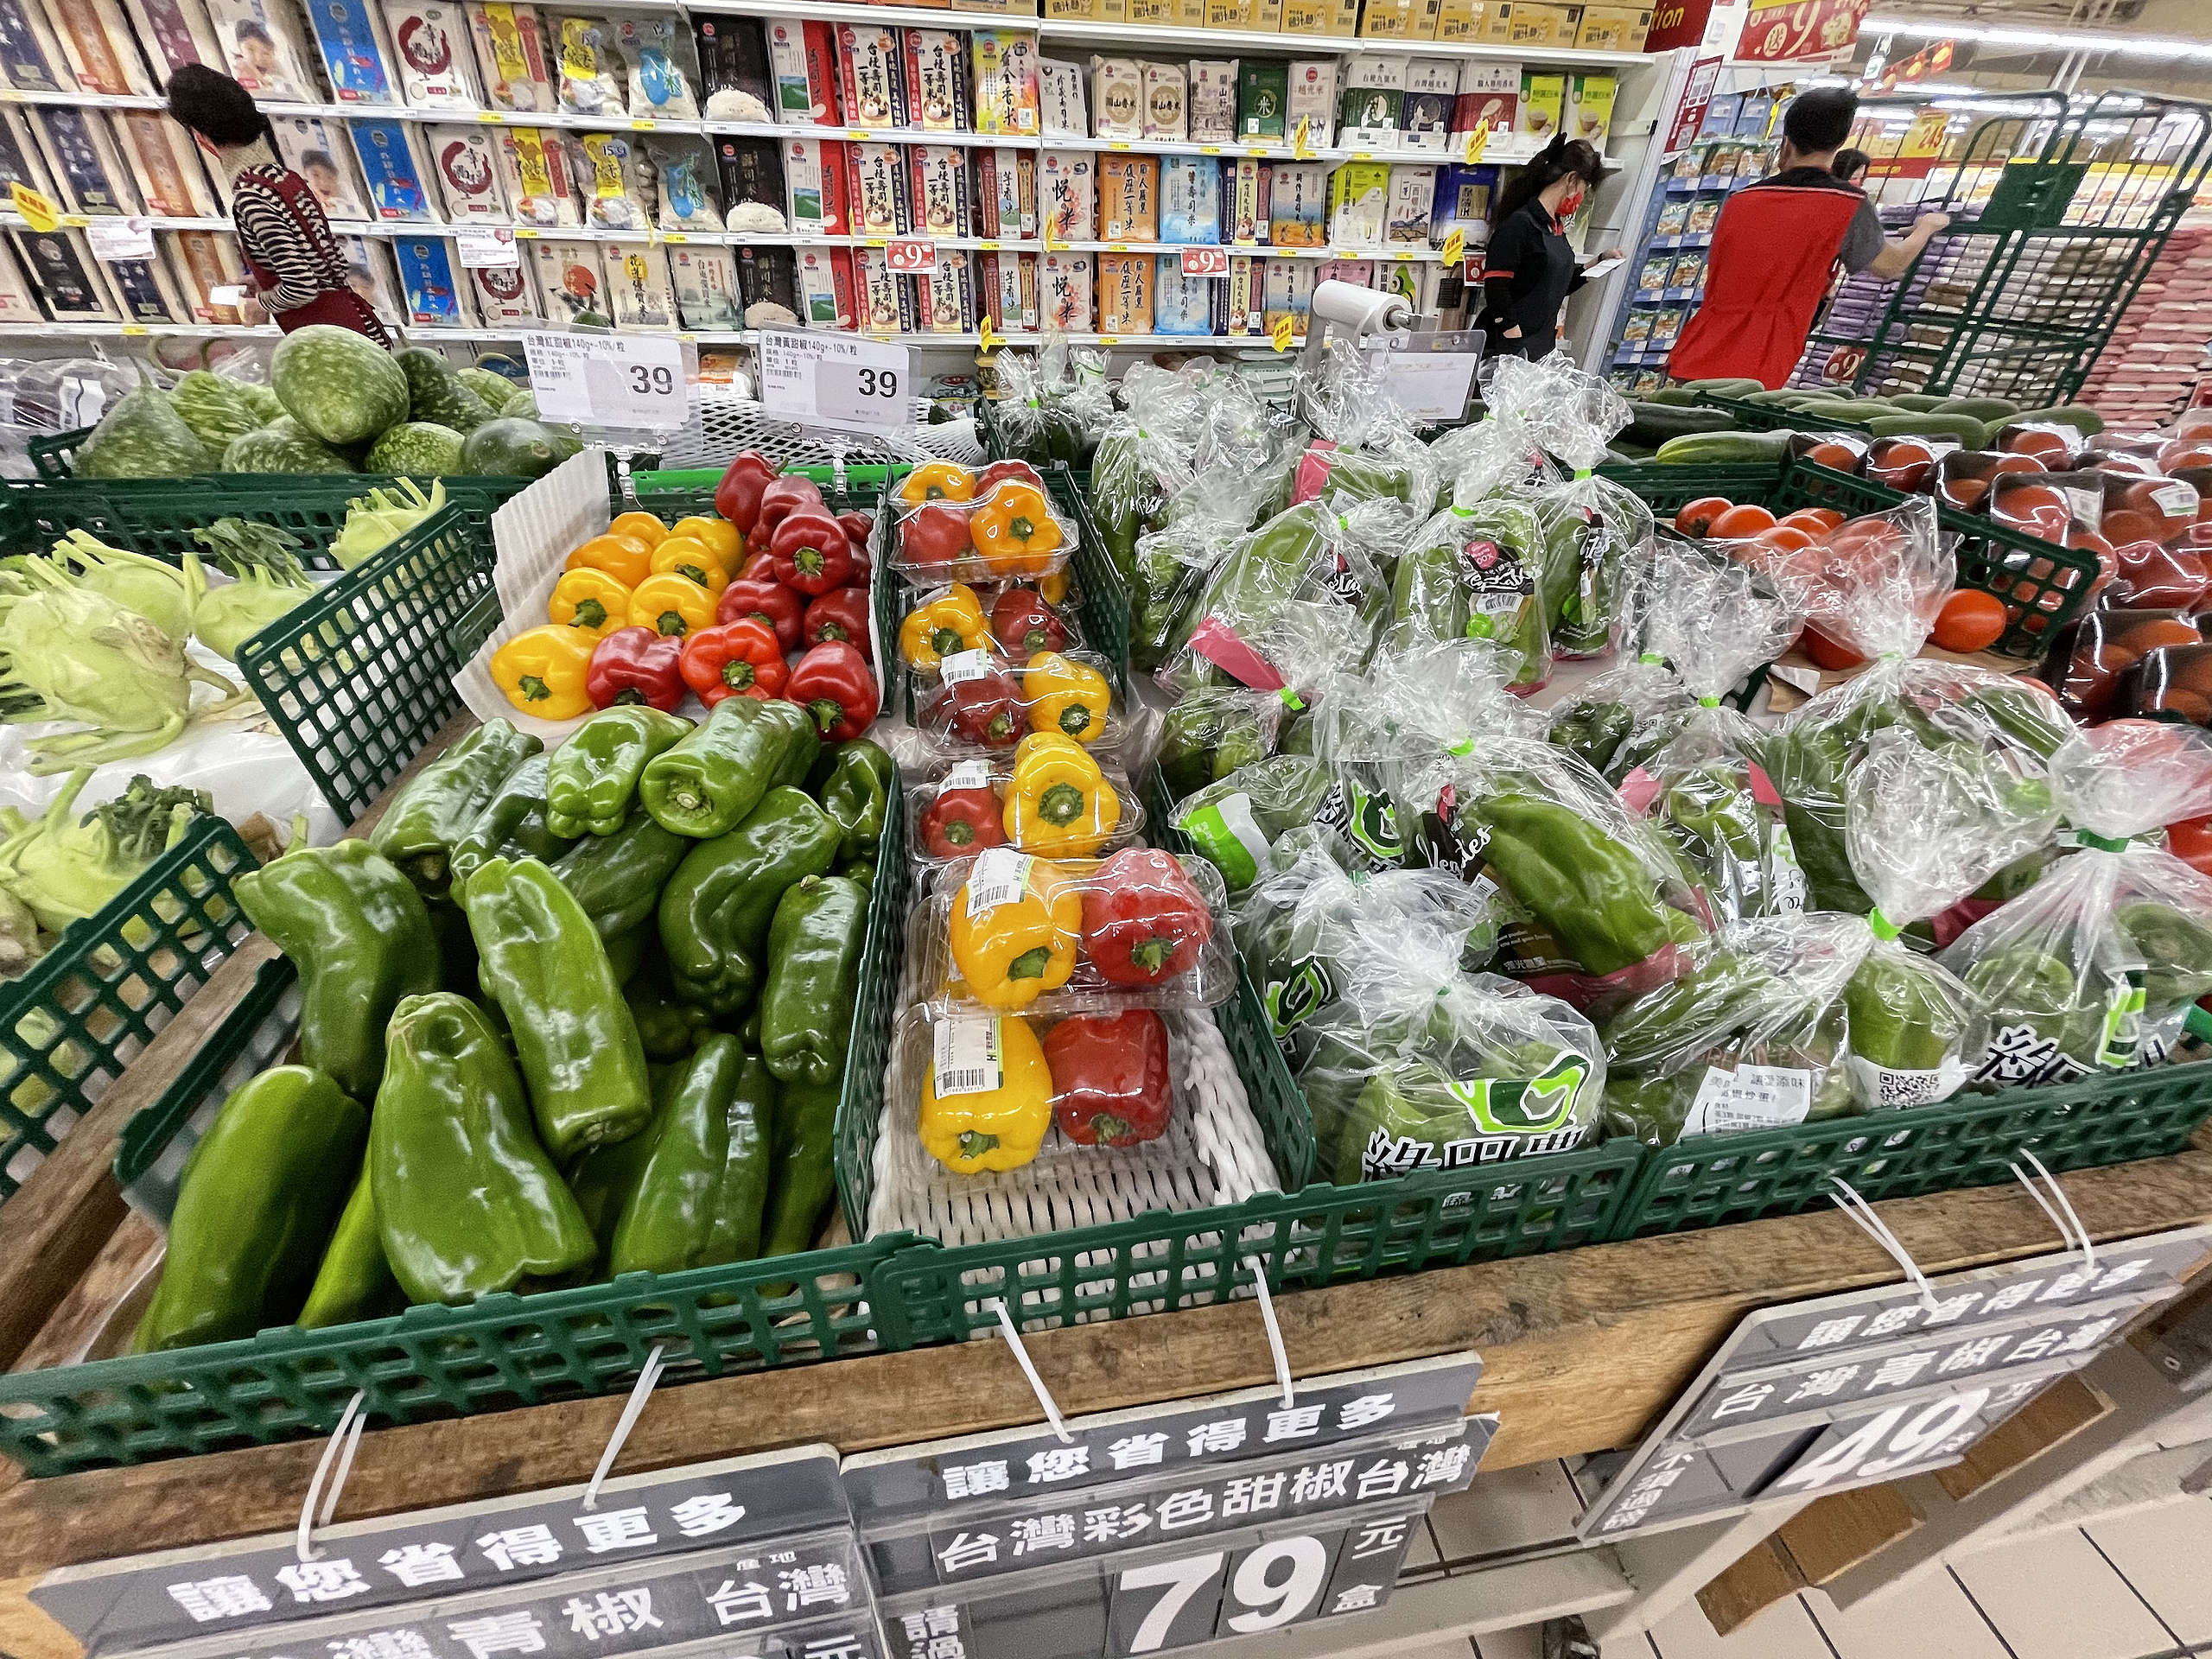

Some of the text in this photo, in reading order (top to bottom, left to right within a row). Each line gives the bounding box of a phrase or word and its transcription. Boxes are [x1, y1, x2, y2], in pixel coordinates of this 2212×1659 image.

[906, 245, 923, 267] 9
[1199, 251, 1215, 272] 9
[630, 365, 673, 396] 39
[857, 368, 898, 398] 39
[1712, 1335, 2012, 1421] 台灣青椒
[942, 1393, 1396, 1500] 讓您省得更多
[1778, 1388, 1990, 1489] 49
[167, 1491, 748, 1624] 讓您省得更多
[1352, 1516, 1408, 1559] 元
[238, 1587, 666, 1659] 灣青椒
[1120, 1535, 1328, 1654] 79
[1331, 1583, 1385, 1614] 盒
